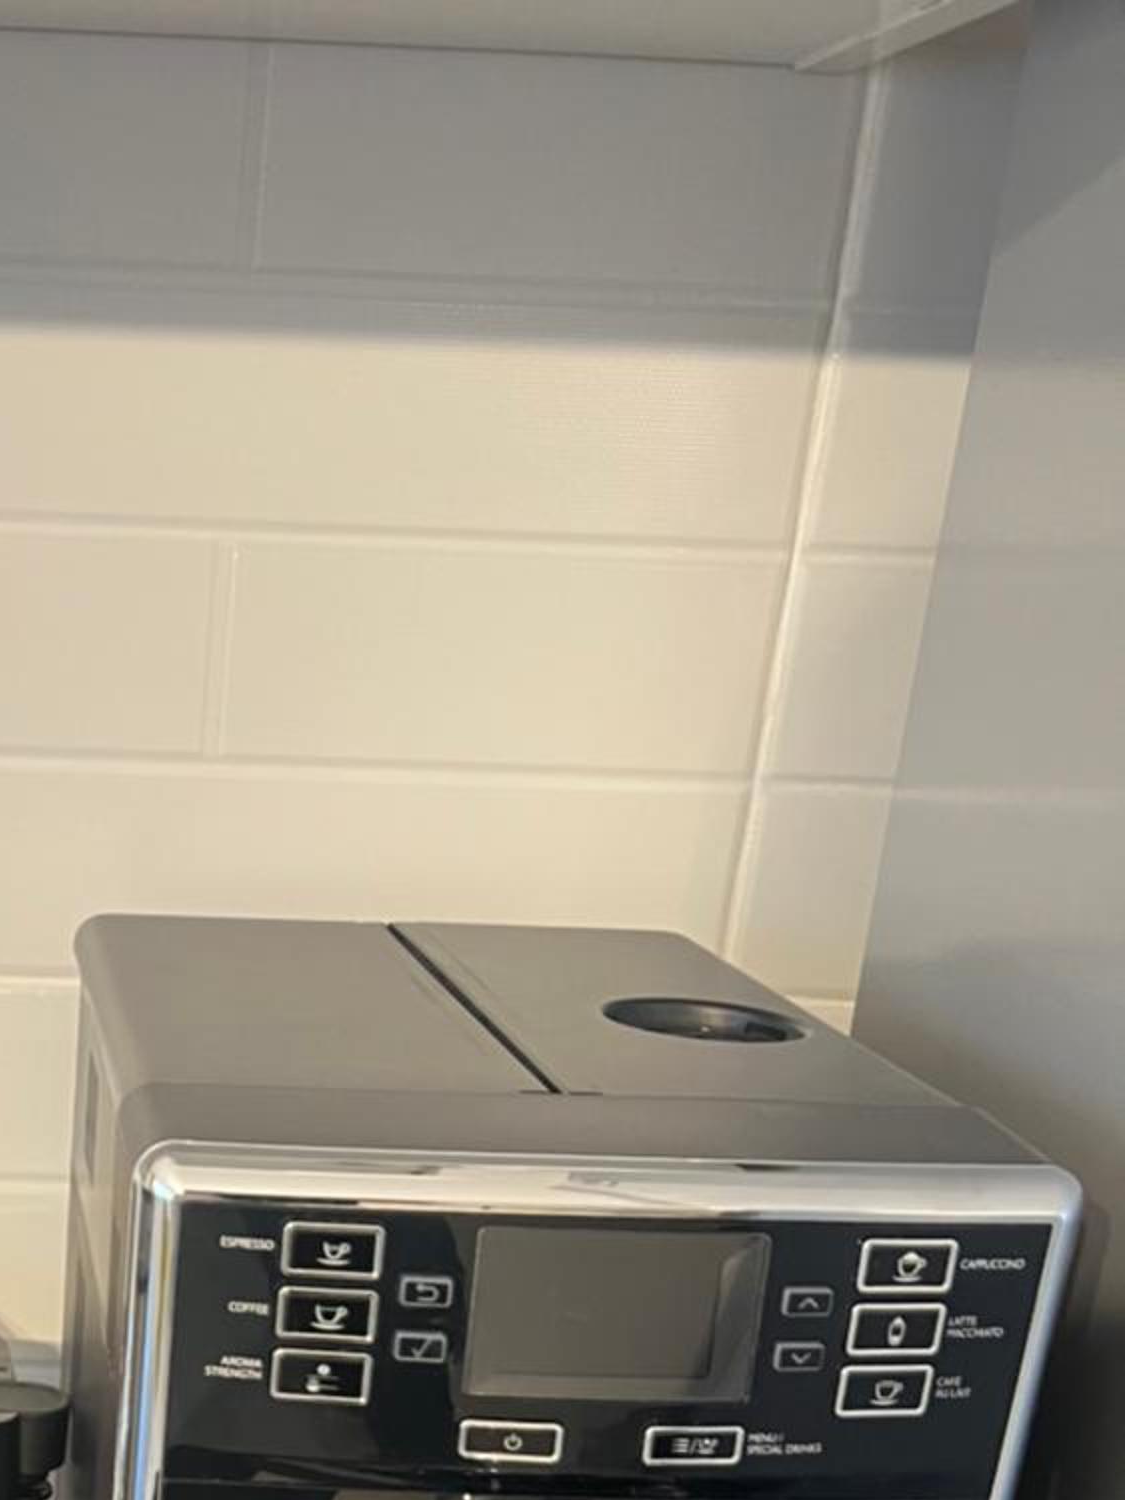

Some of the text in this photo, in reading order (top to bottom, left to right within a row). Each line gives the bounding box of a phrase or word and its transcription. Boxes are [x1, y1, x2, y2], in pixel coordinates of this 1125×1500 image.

[220, 1235, 275, 1251] ESPRESSO
[960, 1258, 1026, 1270] CAPPUCCINO
[227, 1301, 270, 1315] COFFEE
[948, 1316, 978, 1327] LATTE
